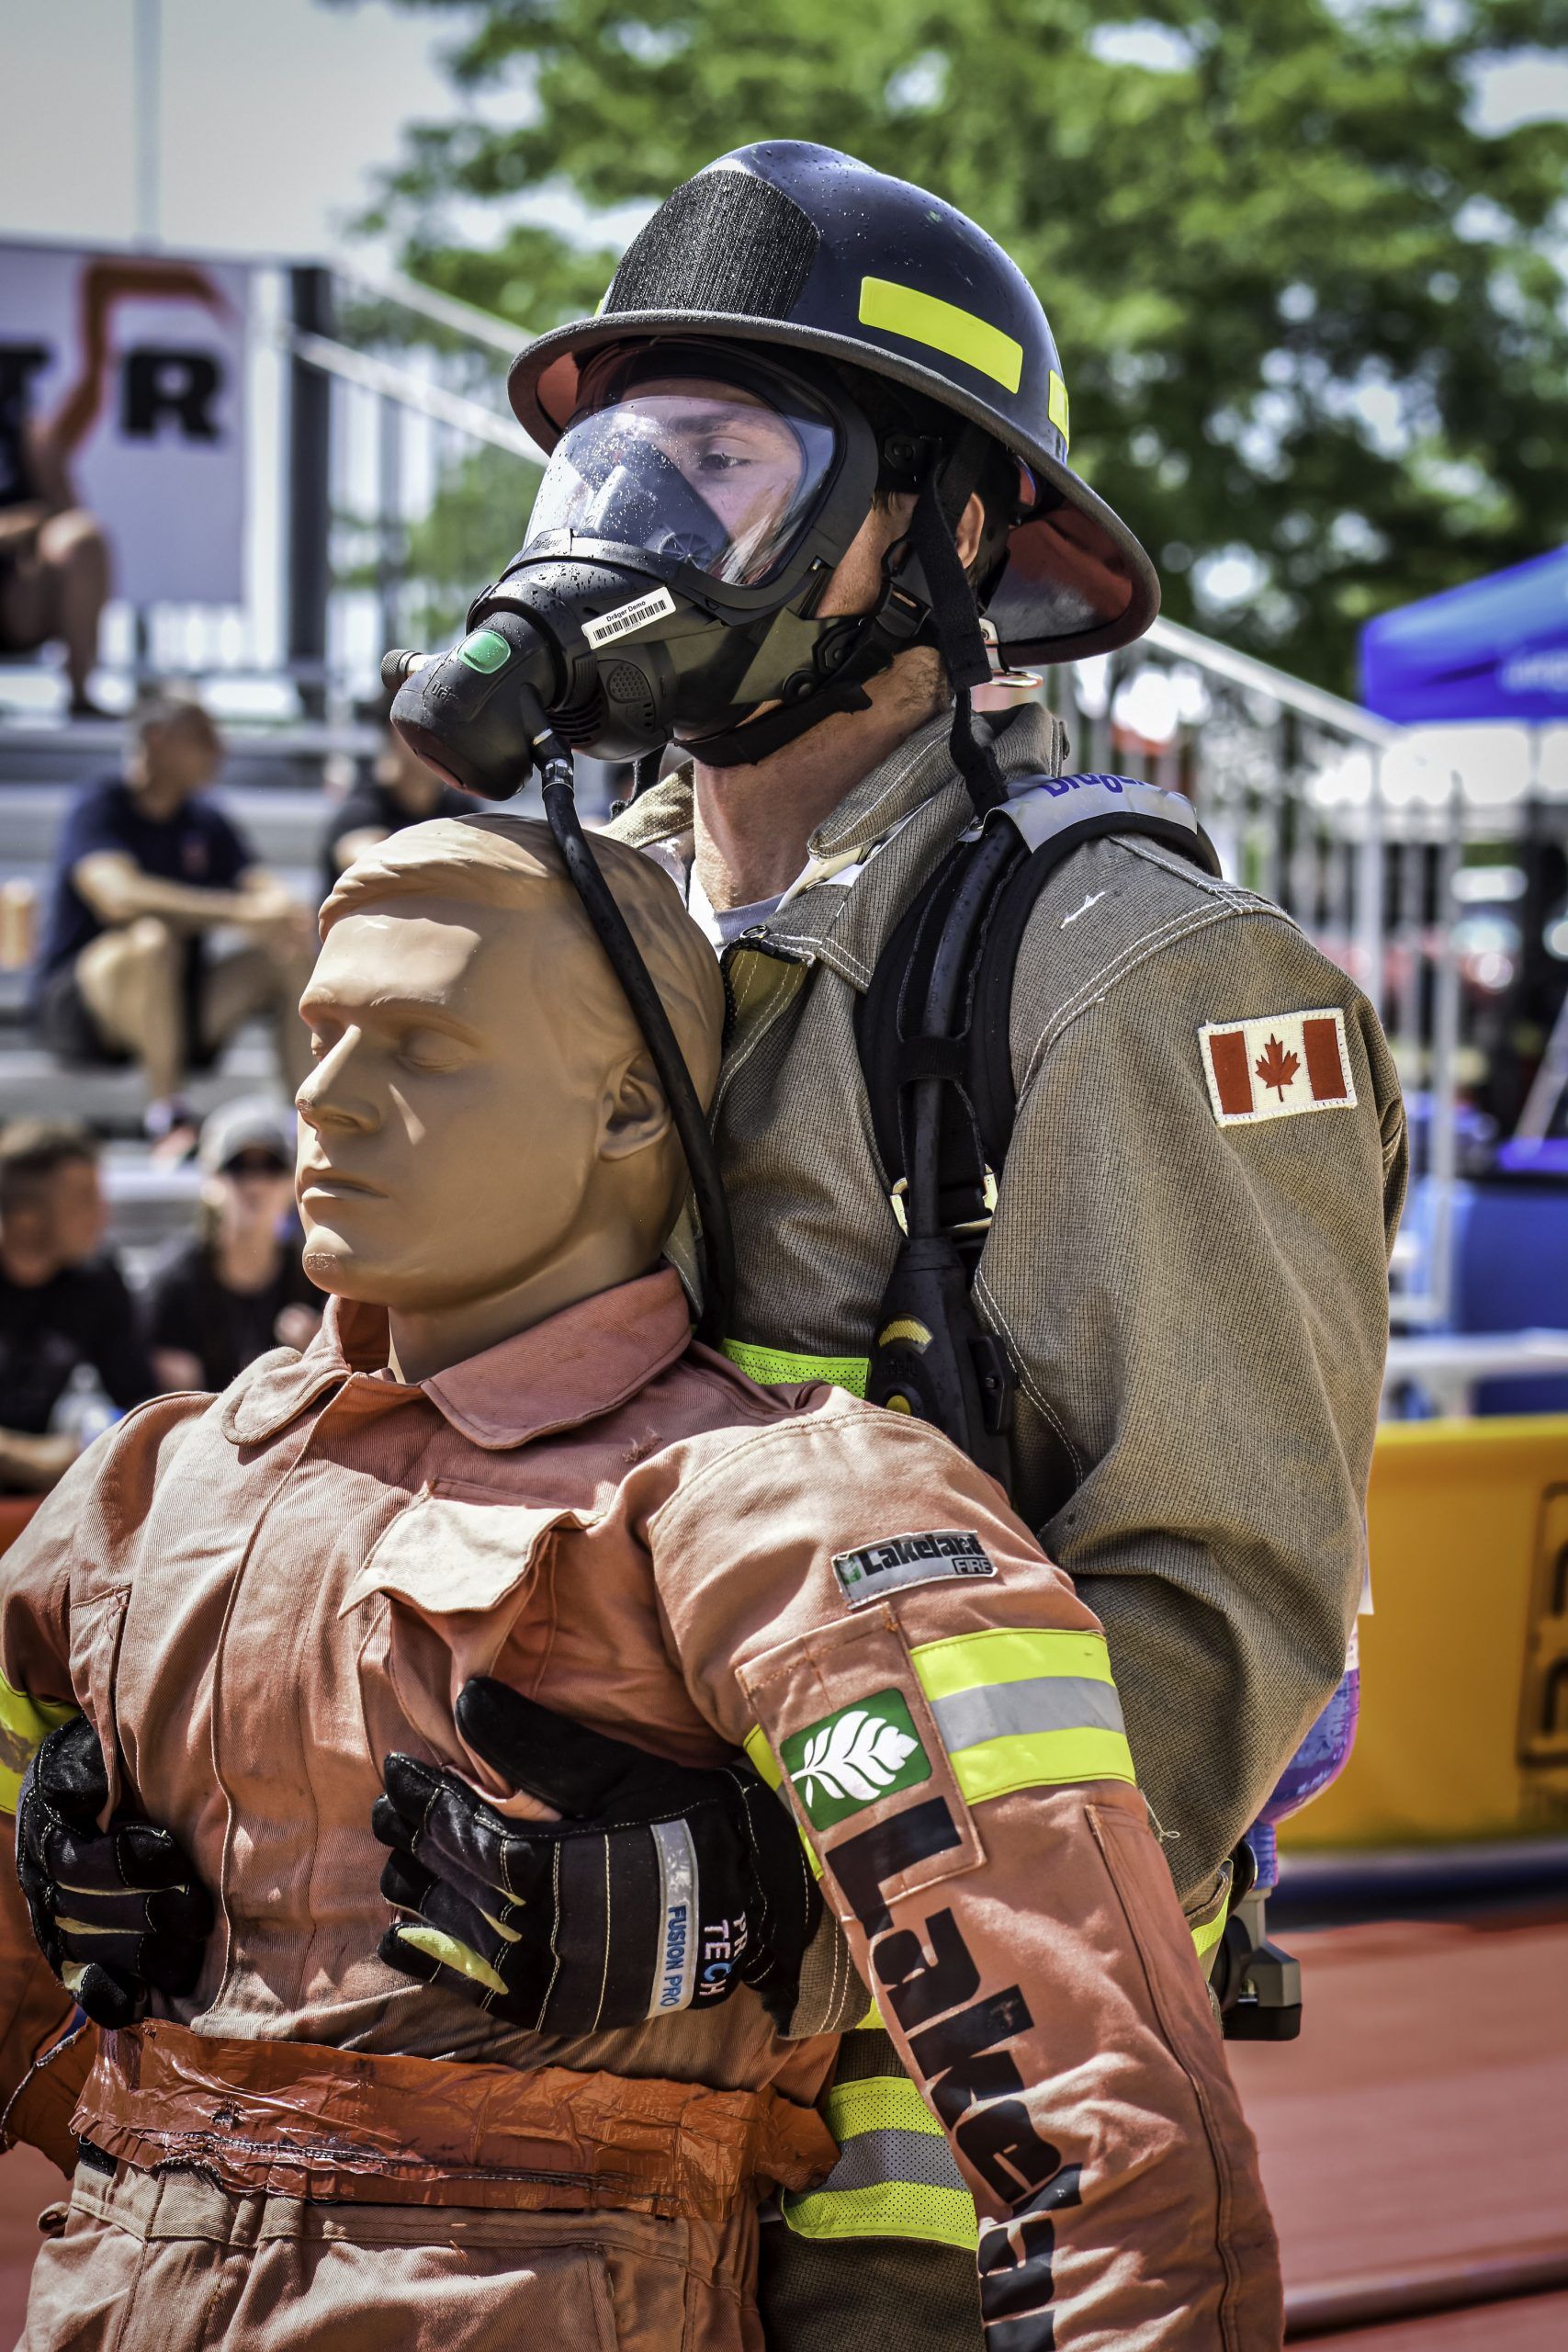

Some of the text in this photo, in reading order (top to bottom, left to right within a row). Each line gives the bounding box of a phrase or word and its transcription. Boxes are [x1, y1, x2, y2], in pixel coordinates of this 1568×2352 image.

[606, 601, 647, 623] Dräger Demo
[858, 1534, 986, 1577] Lakeland
[955, 1559, 992, 1573] FIRE
[660, 1905, 686, 2007] FUSION PRO
[699, 1918, 731, 1996] TECH
